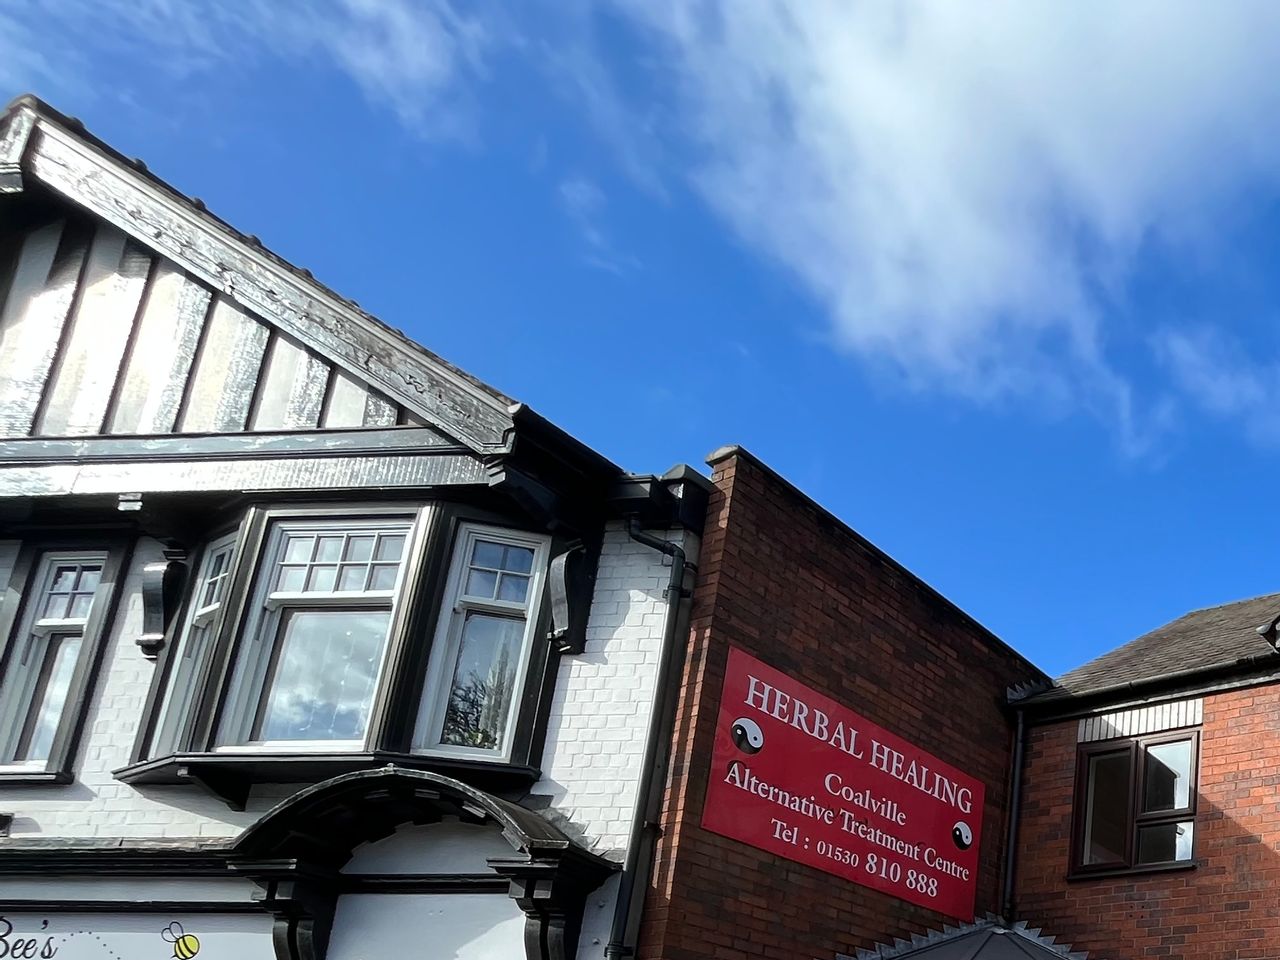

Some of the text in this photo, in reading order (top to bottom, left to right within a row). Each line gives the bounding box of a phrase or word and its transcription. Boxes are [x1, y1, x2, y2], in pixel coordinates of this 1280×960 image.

[744, 674, 973, 814] HERBAL HEALING
[724, 762, 970, 882] Alternative Treatment Centre
[824, 773, 907, 826] Coalville
[770, 818, 798, 845] Tel
[816, 840, 860, 868] 01530
[865, 852, 902, 883] 810
[905, 869, 939, 898] 888
